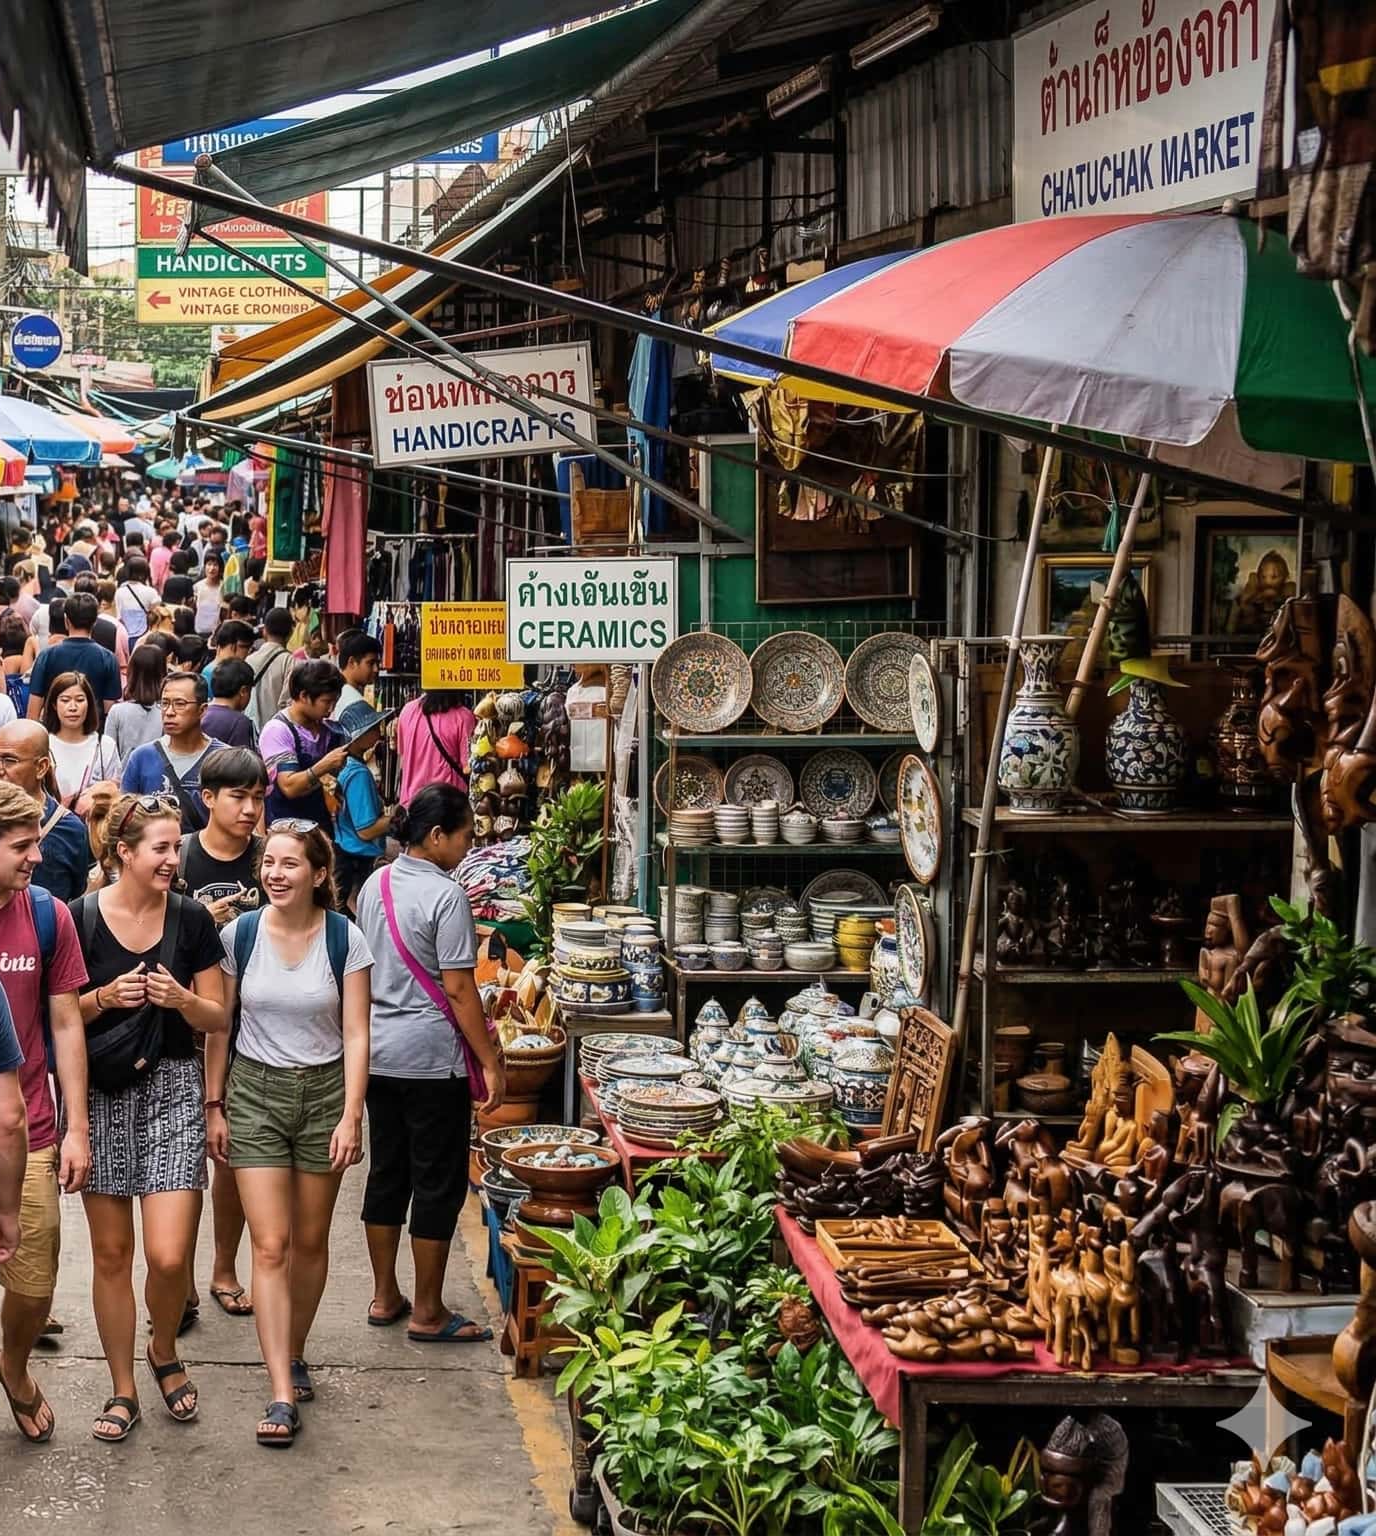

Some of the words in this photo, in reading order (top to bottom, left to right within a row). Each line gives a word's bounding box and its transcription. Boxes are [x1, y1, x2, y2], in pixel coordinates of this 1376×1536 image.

[1041, 143, 1154, 217] CHATUCHAK
[1160, 112, 1255, 187] MARKET
[156, 254, 307, 272] HANDICRAFTS
[178, 286, 235, 298] VINTAGE
[180, 303, 240, 315] VINTAGE
[393, 411, 576, 454] HANDICRAFTS
[518, 619, 667, 649] CERAMICS
